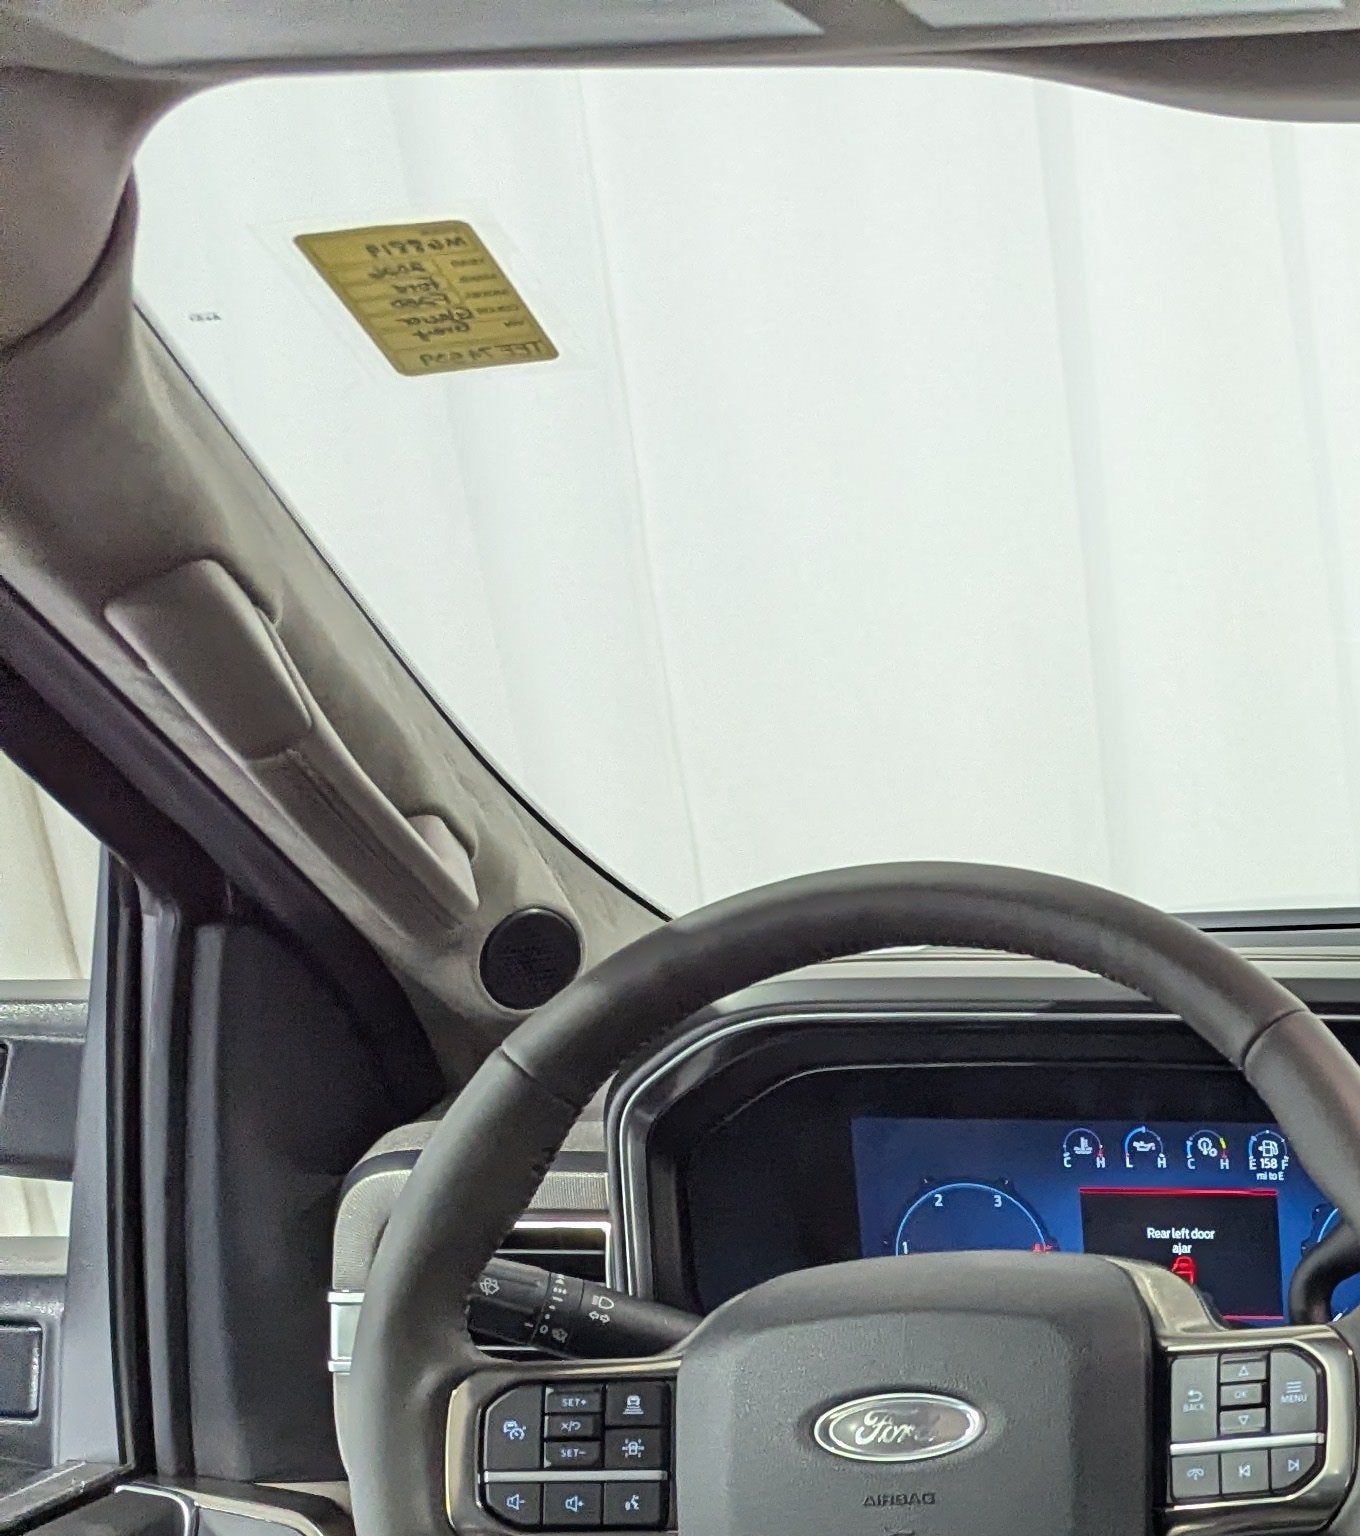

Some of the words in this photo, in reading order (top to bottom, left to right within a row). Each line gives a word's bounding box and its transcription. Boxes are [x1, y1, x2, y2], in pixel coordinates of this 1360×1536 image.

[1063, 1157, 1071, 1168] C
[1096, 1157, 1106, 1168] H
[1125, 1157, 1133, 1168] L
[1157, 1157, 1167, 1168] H
[1187, 1158, 1196, 1169] C
[1220, 1158, 1229, 1169] H
[1260, 1158, 1278, 1169] 158
[934, 1194, 944, 1207] 2
[993, 1194, 1002, 1208] 3
[1147, 1228, 1170, 1239] Rear
[1172, 1227, 1189, 1239] left
[1191, 1228, 1215, 1239] door
[902, 1241, 909, 1255] 1
[1172, 1243, 1192, 1255] ajar
[1281, 1393, 1308, 1403] MENU
[1182, 1403, 1205, 1413] BACK
[863, 1492, 936, 1507] AIRBAG
